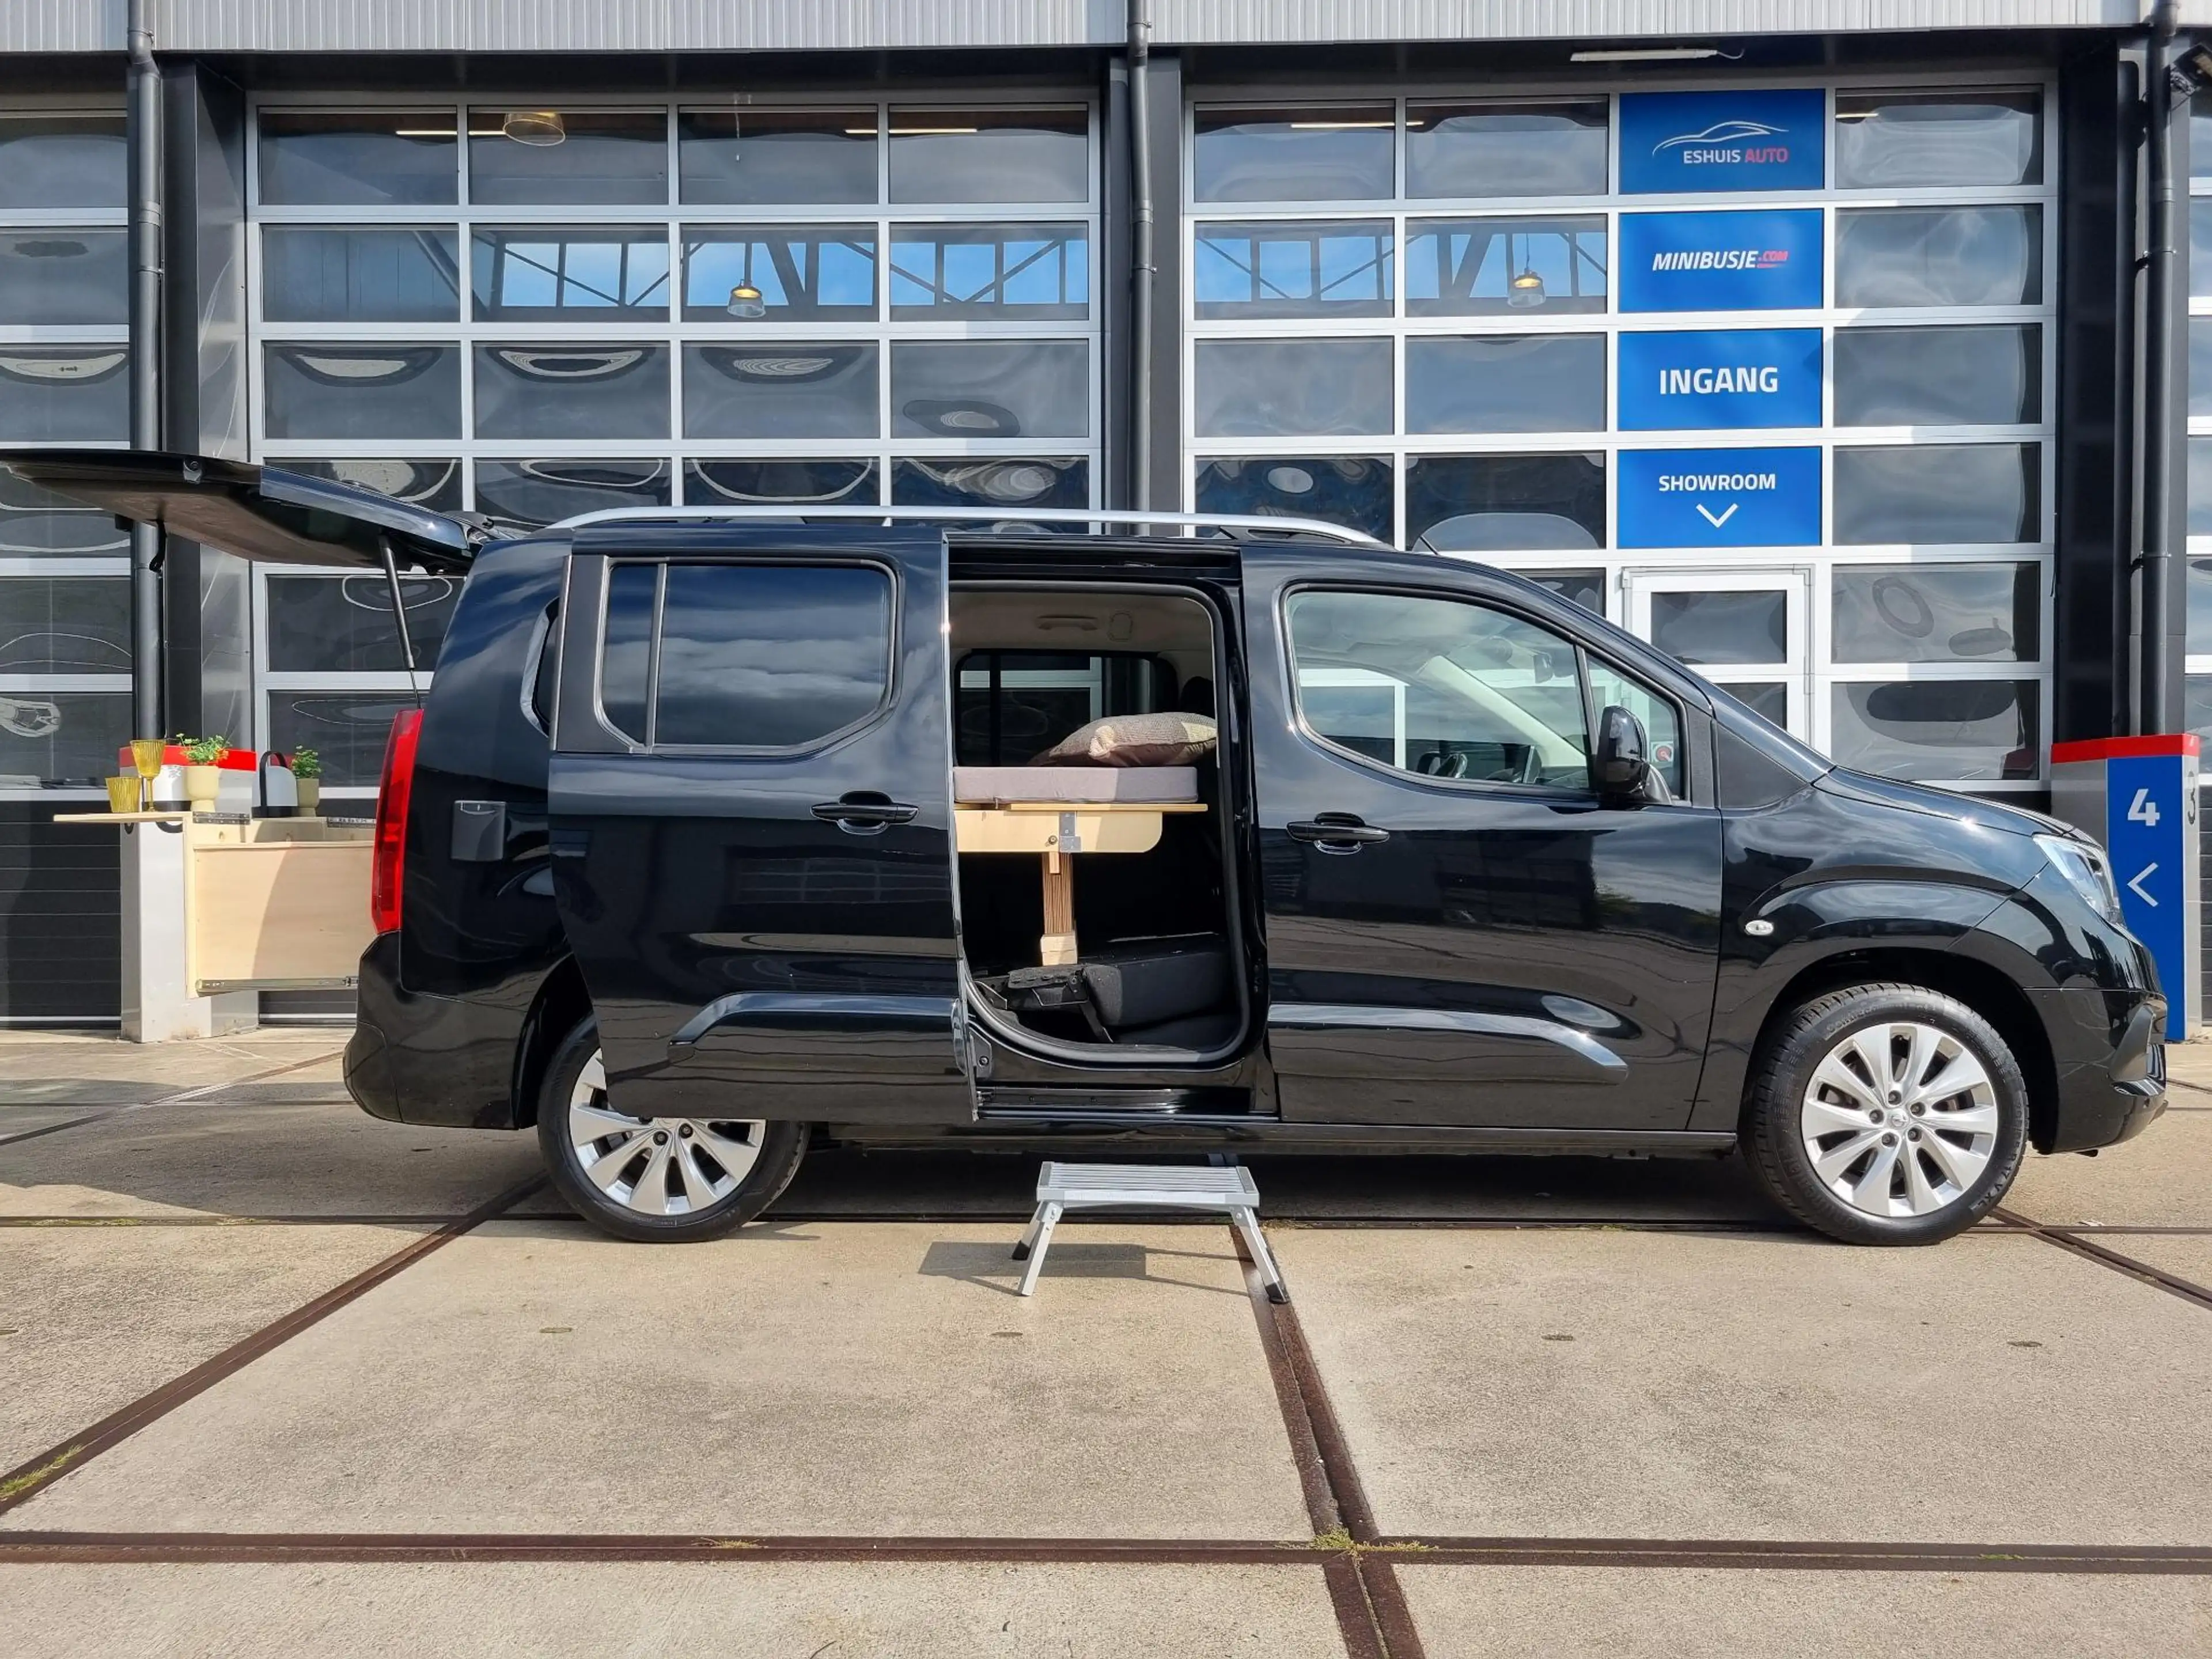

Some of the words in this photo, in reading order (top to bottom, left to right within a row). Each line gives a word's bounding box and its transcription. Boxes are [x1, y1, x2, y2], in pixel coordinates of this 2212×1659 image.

[1683, 150, 1741, 164] ESHUIS
[1744, 147, 1789, 163] AUTO
[1660, 367, 1778, 395] INGANG
[1658, 474, 1776, 491] SHOWROOM
[2127, 788, 2160, 827] 4
